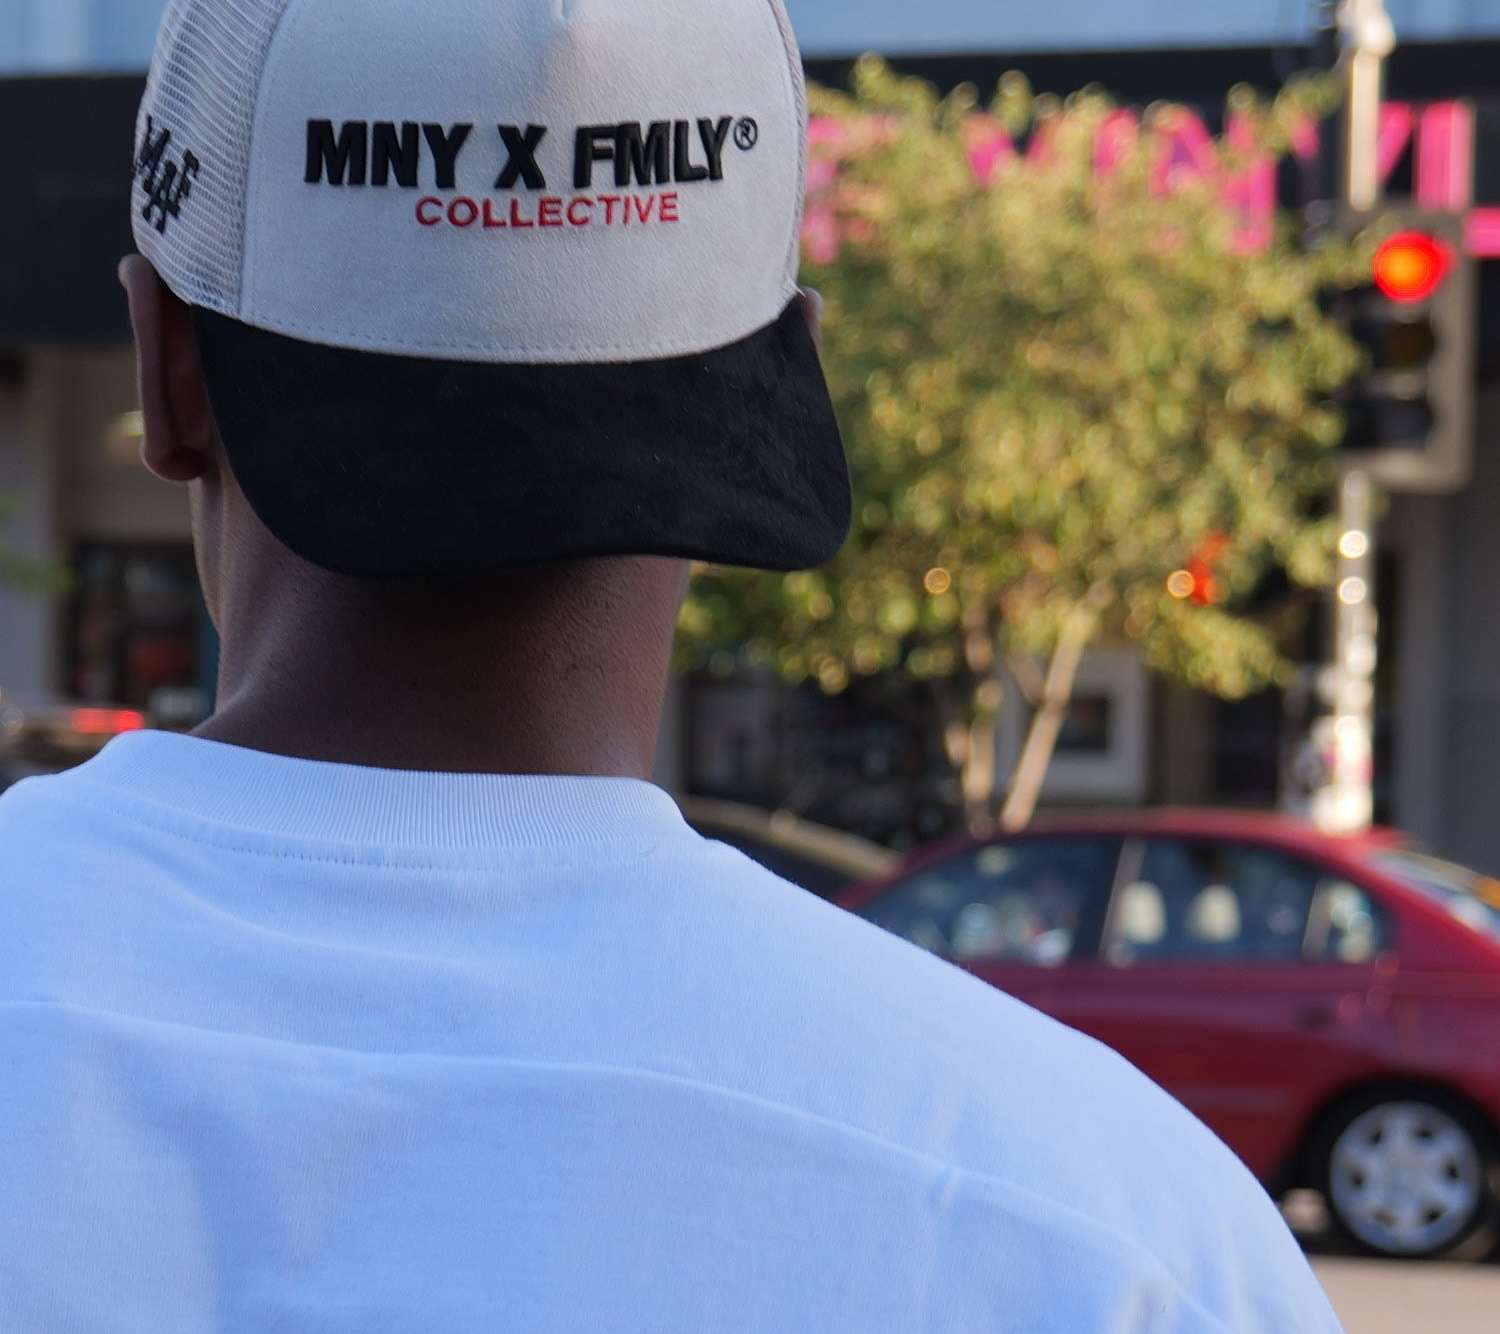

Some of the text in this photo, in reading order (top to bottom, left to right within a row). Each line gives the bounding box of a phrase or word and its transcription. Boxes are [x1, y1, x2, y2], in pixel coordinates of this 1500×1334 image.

[303, 118, 474, 191] MNY
[494, 122, 547, 190] X
[414, 191, 680, 228] COLLECTIVE
